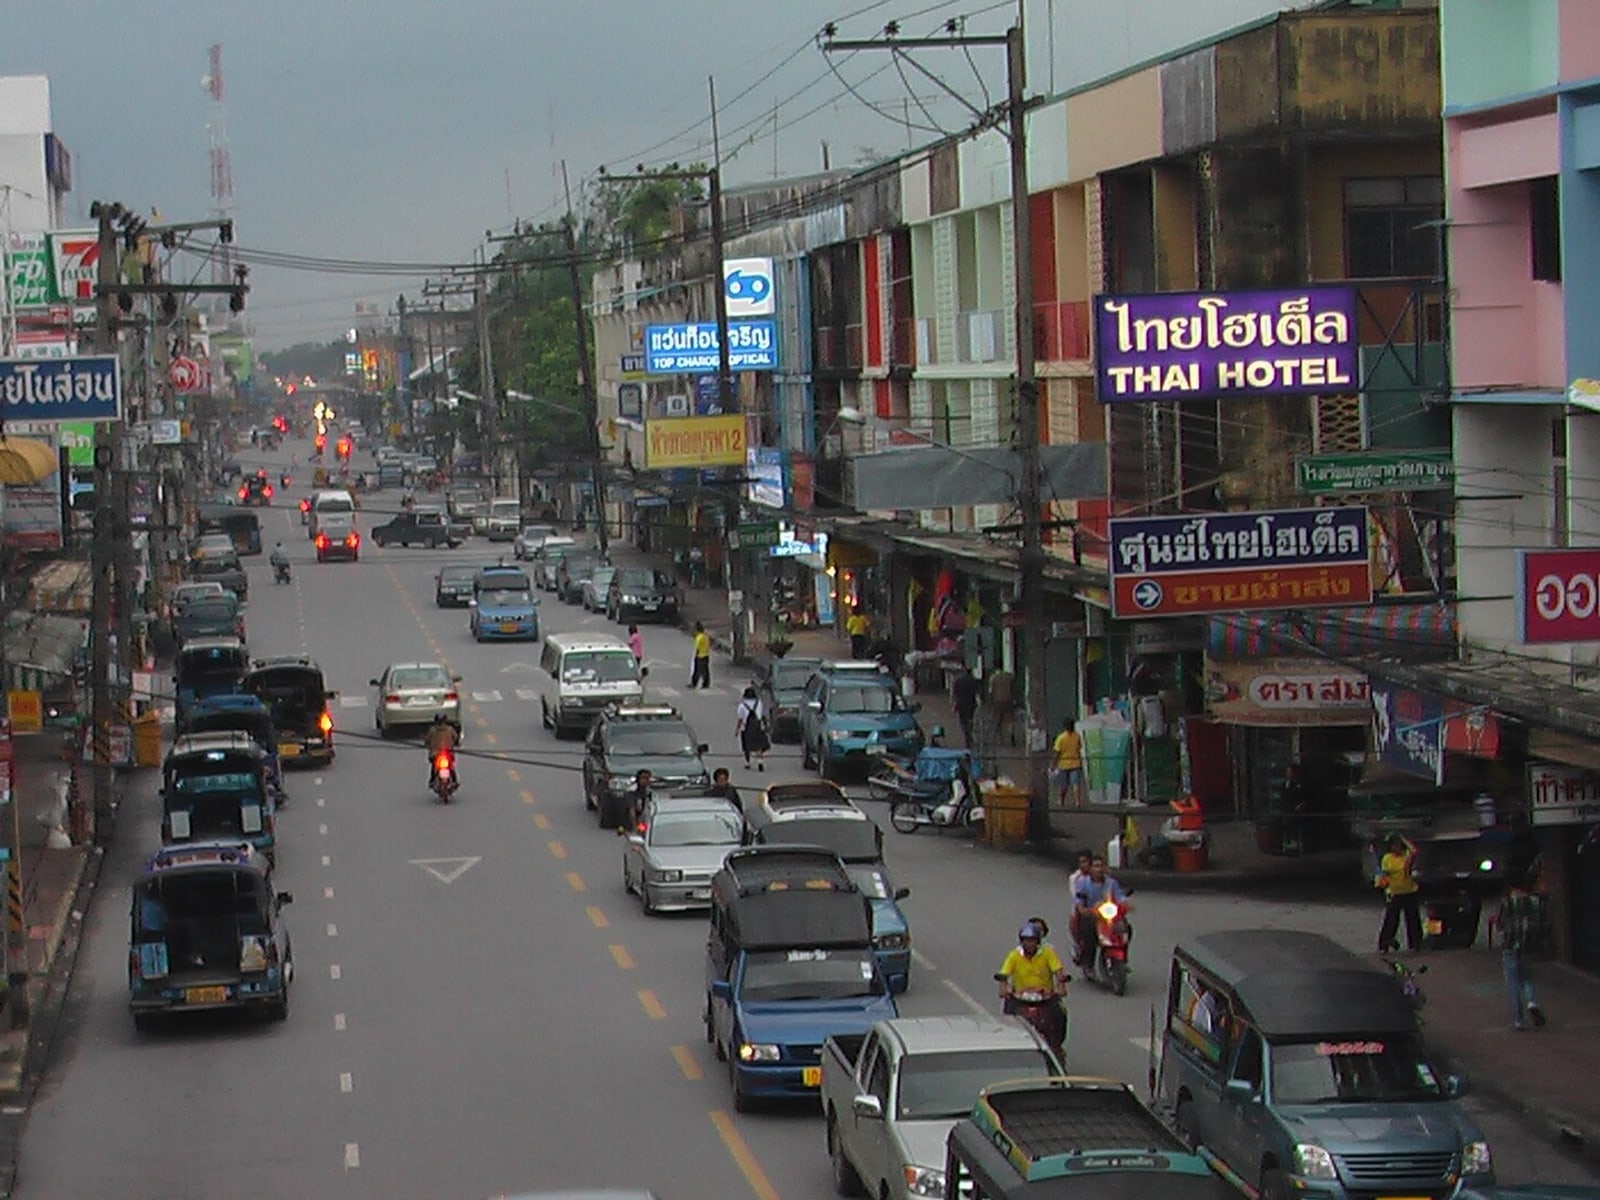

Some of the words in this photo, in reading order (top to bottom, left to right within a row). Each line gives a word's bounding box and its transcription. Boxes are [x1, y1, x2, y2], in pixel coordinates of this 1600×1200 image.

[651, 325, 771, 350] แว่นท็อจริญ
[1105, 297, 1348, 352] ไทยโฮเต็ล
[653, 357, 675, 369] TOP
[676, 355, 721, 368] CHAROE
[729, 353, 771, 367] OPTICAL
[1107, 363, 1200, 394] THAI
[1217, 357, 1350, 389] HOTEL
[731, 428, 742, 451] 2
[1119, 511, 1360, 573] ศูนย์ไทยโฮเต็ล
[1173, 571, 1351, 605] ขายผ้าส่ง
[1535, 573, 1600, 620] ออ
